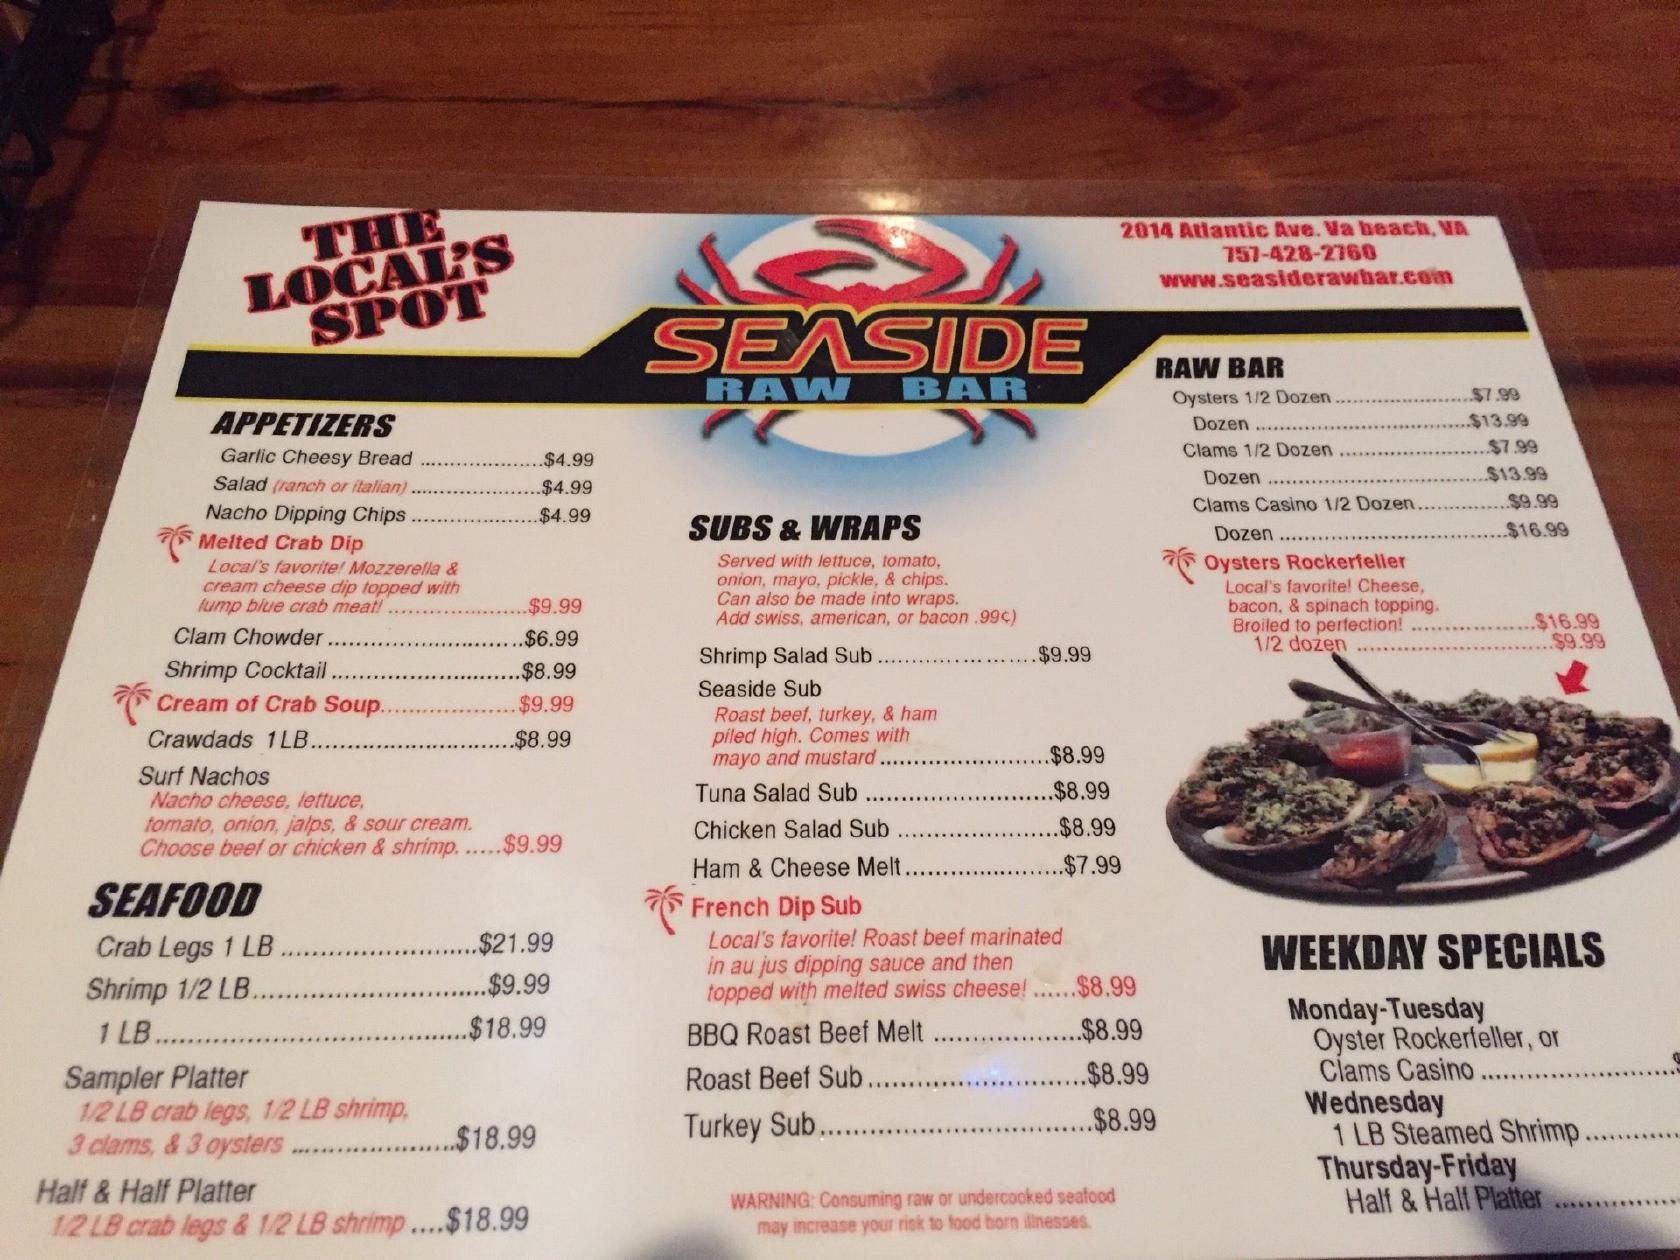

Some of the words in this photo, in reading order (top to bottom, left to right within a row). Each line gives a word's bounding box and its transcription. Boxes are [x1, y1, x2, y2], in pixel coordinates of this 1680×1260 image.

[300, 208, 448, 261] THE
[1121, 223, 1174, 239] 2014
[1180, 222, 1269, 239] Atlantic
[1275, 222, 1320, 238] Ave.
[1324, 221, 1355, 236] Va
[1439, 221, 1469, 236] VA
[1223, 243, 1377, 263] 757-428-2760
[243, 233, 516, 313] LOCAL'S
[1159, 268, 1453, 288] www.seasiderawbar.com
[310, 280, 490, 347] SPOT
[645, 317, 1089, 375] SEASIDE
[1156, 357, 1221, 379] RAW
[1228, 356, 1284, 379] BAR
[705, 376, 852, 403] RAW
[902, 376, 1029, 401] BAR
[1172, 390, 1239, 409] Oysters
[1245, 390, 1271, 404] 1/2
[1275, 389, 1332, 404] Dozen
[1469, 387, 1521, 403] $7.99
[210, 411, 396, 438] APPETIZERS
[1193, 416, 1249, 431] Dozen
[1467, 413, 1529, 430] $13.99
[221, 447, 277, 464] Garlic
[282, 449, 353, 469] Cheesy
[358, 450, 413, 466] Bread
[544, 451, 594, 469] $4.99
[213, 475, 268, 492] Salad
[272, 479, 327, 494] (ranch
[330, 481, 349, 493] or
[352, 479, 408, 496] italian)
[542, 479, 592, 496] $4.99
[206, 504, 268, 520] Nacho
[274, 505, 347, 525] Dipping
[353, 506, 406, 526] Chips
[539, 507, 591, 525] $4.99
[1193, 497, 1250, 513] Clams
[1255, 496, 1318, 512] Casino
[1324, 496, 1351, 511] 1/2
[1355, 495, 1415, 511] Dozen
[1508, 493, 1559, 510] $9.99
[689, 514, 773, 541] SUBS
[779, 519, 801, 541] &
[810, 514, 921, 541] WRAPS
[1214, 525, 1273, 542] Dozen
[1506, 521, 1570, 539] $16.99
[198, 533, 270, 550] Melted
[277, 534, 323, 551] Crab
[330, 535, 364, 555] Dip
[717, 553, 776, 568] Served
[781, 554, 813, 568] with
[817, 554, 875, 569] lettuce,
[882, 554, 941, 569] tomato,
[1204, 554, 1280, 574] Oysters
[1286, 553, 1406, 570] Rockerfeller
[1225, 579, 1281, 594] Local's
[1287, 578, 1351, 594] favorite!
[1357, 578, 1424, 594] Cheese,
[716, 610, 751, 626] Add
[754, 610, 803, 626] swiss,
[810, 610, 890, 626] american,
[897, 612, 914, 625] or
[919, 610, 969, 625] bacon
[174, 627, 227, 645] Clam
[237, 627, 324, 646] Chowder
[524, 629, 579, 648] $6.99
[1254, 635, 1284, 653] 1/2
[1289, 634, 1347, 656] dozen
[1551, 632, 1606, 652] $9.99
[700, 647, 767, 669] Shrimp
[773, 647, 828, 664] Salad
[835, 646, 872, 663] Sub
[1039, 645, 1091, 665] $9.99
[165, 660, 241, 683] Shrimp
[245, 661, 327, 679] Cocktail
[521, 661, 576, 682] $8.99
[698, 680, 776, 697] Seaside
[784, 679, 822, 697] Sub
[157, 694, 229, 712] Cream
[235, 695, 260, 713] of
[265, 695, 317, 713] Crab
[324, 695, 381, 718] Soup
[518, 694, 575, 715] $9.99
[148, 729, 254, 749] Crawdads
[268, 730, 276, 749] 1
[280, 730, 309, 749] LB
[515, 729, 571, 751] $8.99
[138, 766, 185, 786] Surf
[190, 766, 270, 786] Nachos
[695, 783, 746, 803] Tuna
[753, 782, 810, 802] Salad
[818, 782, 858, 802] Sub
[1053, 780, 1110, 802] $8.99
[693, 858, 740, 879] Ham
[749, 858, 762, 878] &
[771, 857, 850, 878] Cheese
[857, 856, 901, 877] Melt
[1064, 854, 1121, 877] $7.99
[87, 882, 263, 918] SEAFOOD
[692, 896, 769, 918] French
[779, 896, 816, 921] Dip
[821, 895, 862, 916] Sub
[96, 935, 152, 958] Crab
[158, 935, 214, 964] Legs
[226, 936, 233, 957] 1
[242, 934, 274, 957] LB
[479, 932, 554, 956] $21.99
[1261, 934, 1428, 971] WEEKDAY
[1438, 931, 1605, 970] SPECIALS
[1288, 997, 1484, 1026] Monday-Tuesday
[100, 1022, 109, 1044] 1
[118, 1020, 151, 1045] LB
[469, 1015, 546, 1042] $18.99
[688, 1022, 738, 1047] BBQ
[747, 1022, 811, 1046] Roast
[819, 1019, 869, 1044] Beef
[877, 1019, 924, 1043] Melt
[1081, 1017, 1143, 1044] $8.99
[1313, 1028, 1385, 1057] Oyster
[1392, 1025, 1532, 1051] Rockerfeller,
[1538, 1030, 1559, 1048] or
[64, 1065, 165, 1096] Sampler
[171, 1064, 249, 1089] Platter
[1320, 1058, 1391, 1082] Clams
[1396, 1057, 1474, 1082] Casino
[1304, 1089, 1444, 1118] Wednesday
[684, 1113, 762, 1144] Turkey
[771, 1111, 815, 1137] Sub
[1093, 1106, 1156, 1135] $8.99
[1333, 1123, 1344, 1146] 1
[1353, 1121, 1385, 1146] LB
[1391, 1119, 1494, 1146] Steamed
[1499, 1118, 1579, 1148] Shrimp
[1317, 1152, 1516, 1185] Thursday-Friday
[35, 1178, 89, 1205] Half
[93, 1179, 110, 1204] &
[119, 1178, 171, 1204] Half
[176, 1177, 257, 1204] Platter
[731, 1191, 814, 1210] WARNING:
[819, 1190, 903, 1211] Consuming
[906, 1193, 935, 1207] raw
[937, 1192, 954, 1207] or
[958, 1187, 1054, 1207] undercooked
[1057, 1187, 1116, 1205] seafood
[1345, 1187, 1392, 1214] Half
[1401, 1188, 1418, 1213] &
[1423, 1186, 1470, 1213] Half
[1473, 1184, 1542, 1211] Platter
